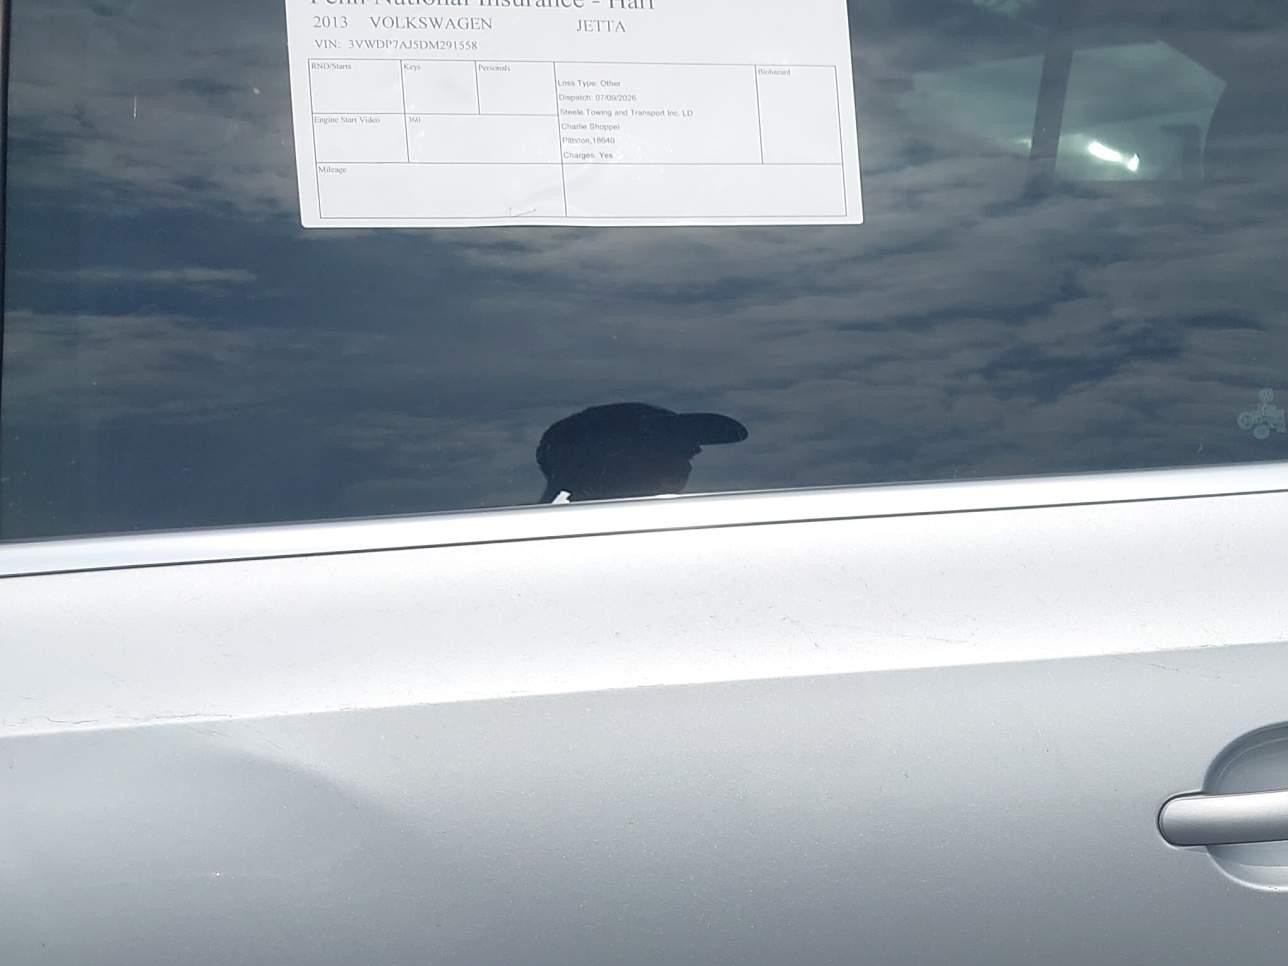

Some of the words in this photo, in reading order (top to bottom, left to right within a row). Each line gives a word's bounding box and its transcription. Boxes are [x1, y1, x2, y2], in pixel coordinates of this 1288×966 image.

[312, 16, 349, 29] 2013
[369, 16, 493, 30] VOLKSWAGEN
[576, 19, 626, 32] JETTA
[314, 39, 342, 49] VIN:
[349, 39, 478, 50] 3VWDP7AJ5DM291558
[478, 63, 511, 72] Personals
[557, 79, 575, 87] Loss
[586, 108, 613, 117] Towing
[614, 109, 628, 117] and
[631, 109, 665, 118] Transport
[314, 116, 339, 124] Engine
[340, 116, 358, 124] Start
[359, 116, 381, 124] Video
[599, 152, 613, 160] Yes
